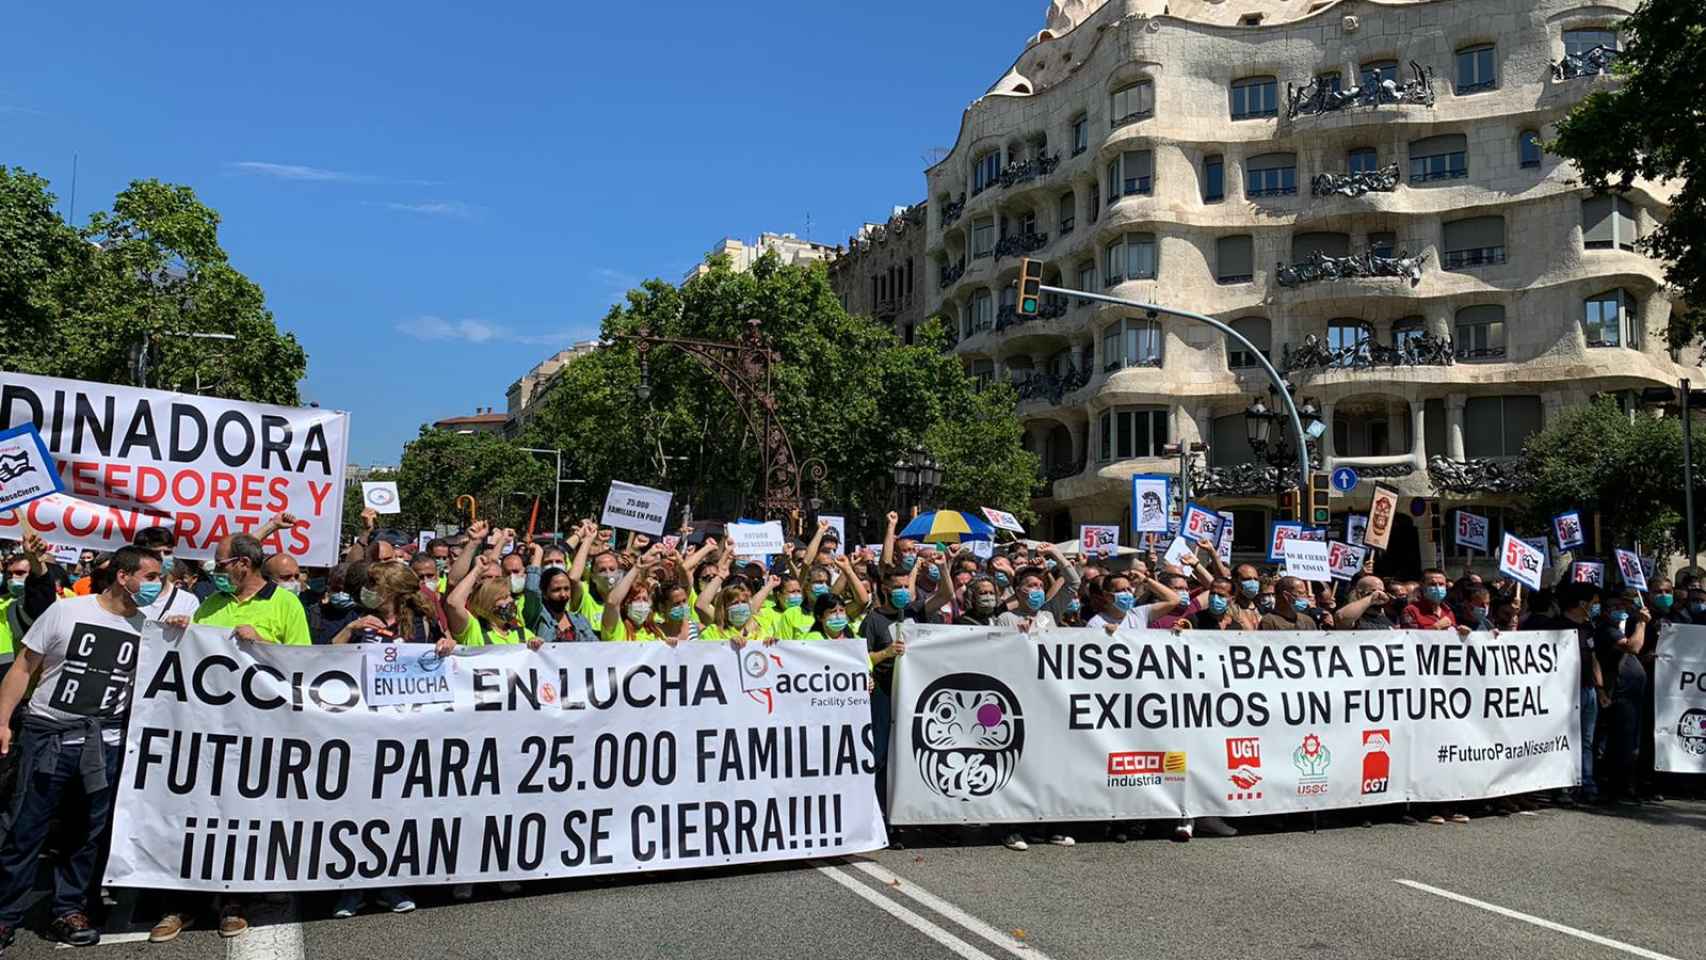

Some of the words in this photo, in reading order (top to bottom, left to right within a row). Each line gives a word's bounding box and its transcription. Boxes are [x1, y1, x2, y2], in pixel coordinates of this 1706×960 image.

[308, 480, 332, 516] Y
[1037, 643, 1206, 681] NISSAN:
[1218, 644, 1353, 689] ¡BASTA
[1359, 643, 1406, 678] DE
[1415, 642, 1558, 677] MENTIRAS!
[374, 678, 393, 696] EN
[398, 675, 449, 696] LUCHA
[473, 668, 541, 711] EN
[559, 664, 728, 711] LUCHA
[811, 696, 846, 708] Facility
[1069, 691, 1270, 729] EXIGIMOS
[1281, 690, 1331, 725] UN
[1345, 687, 1472, 723] FUTURO
[1483, 685, 1549, 719] REAL
[134, 727, 351, 801] FUTURO
[371, 737, 501, 800] PARA
[517, 730, 677, 794] 25.000
[696, 723, 876, 783] FAMILIAS
[1111, 755, 1160, 771] CCOO
[1231, 739, 1260, 759] UGT
[1437, 735, 1570, 764] #FuturoParaNissanYA
[1107, 774, 1162, 788] indústria
[1363, 777, 1388, 793] CGT
[480, 812, 546, 873] NO
[561, 807, 614, 868] SE
[630, 794, 843, 862] CIERRA!!!!
